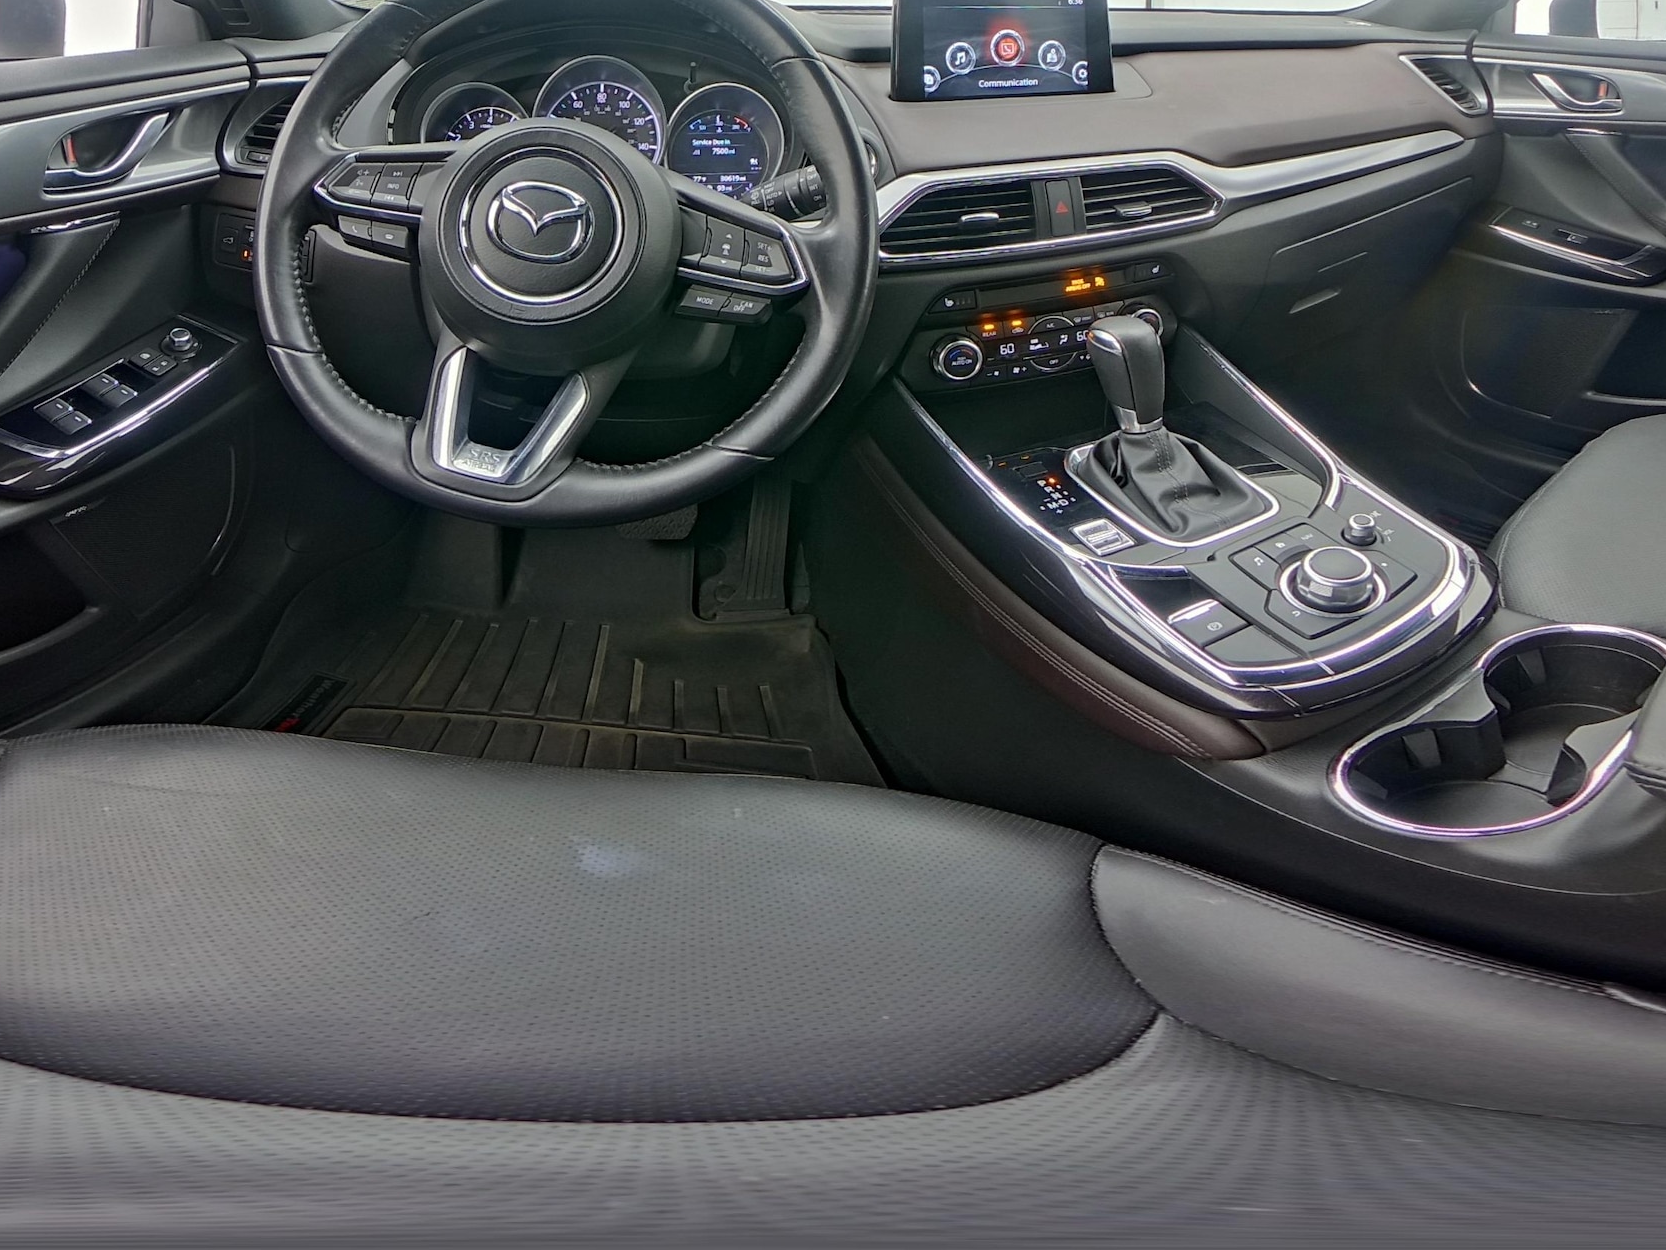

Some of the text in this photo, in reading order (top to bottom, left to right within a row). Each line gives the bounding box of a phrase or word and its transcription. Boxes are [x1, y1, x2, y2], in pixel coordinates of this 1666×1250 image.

[978, 77, 1039, 89] Communication
[596, 92, 607, 100] 80
[468, 121, 475, 129] 3
[757, 254, 769, 263] RES
[696, 297, 714, 305] MODE
[470, 449, 500, 462] SRS
